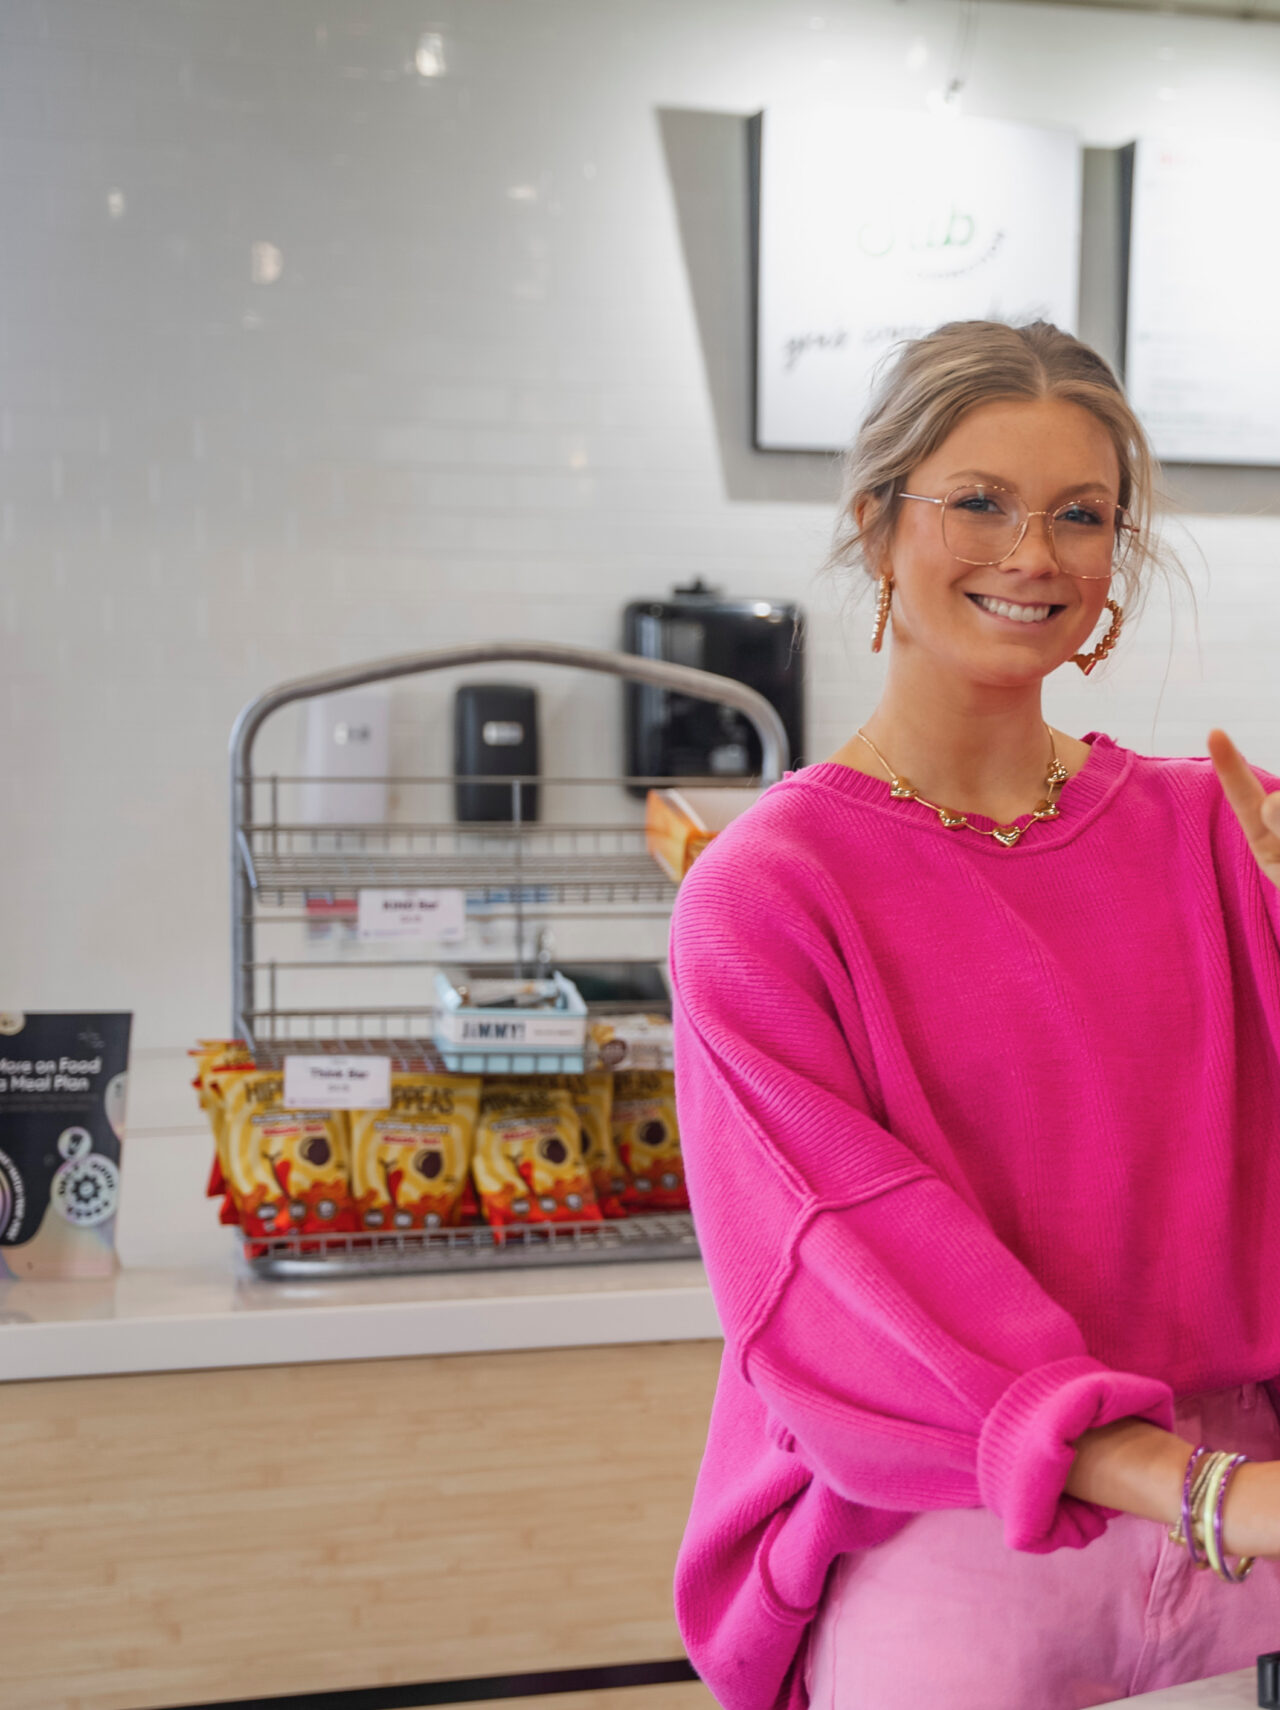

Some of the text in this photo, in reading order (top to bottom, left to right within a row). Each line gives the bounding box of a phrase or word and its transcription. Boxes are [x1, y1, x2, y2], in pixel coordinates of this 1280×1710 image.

[35, 1060, 56, 1075] on
[59, 1056, 102, 1075] Food
[10, 1075, 51, 1092] Meal
[53, 1075, 90, 1092] Plan
[391, 1086, 455, 1115] PPEAS
